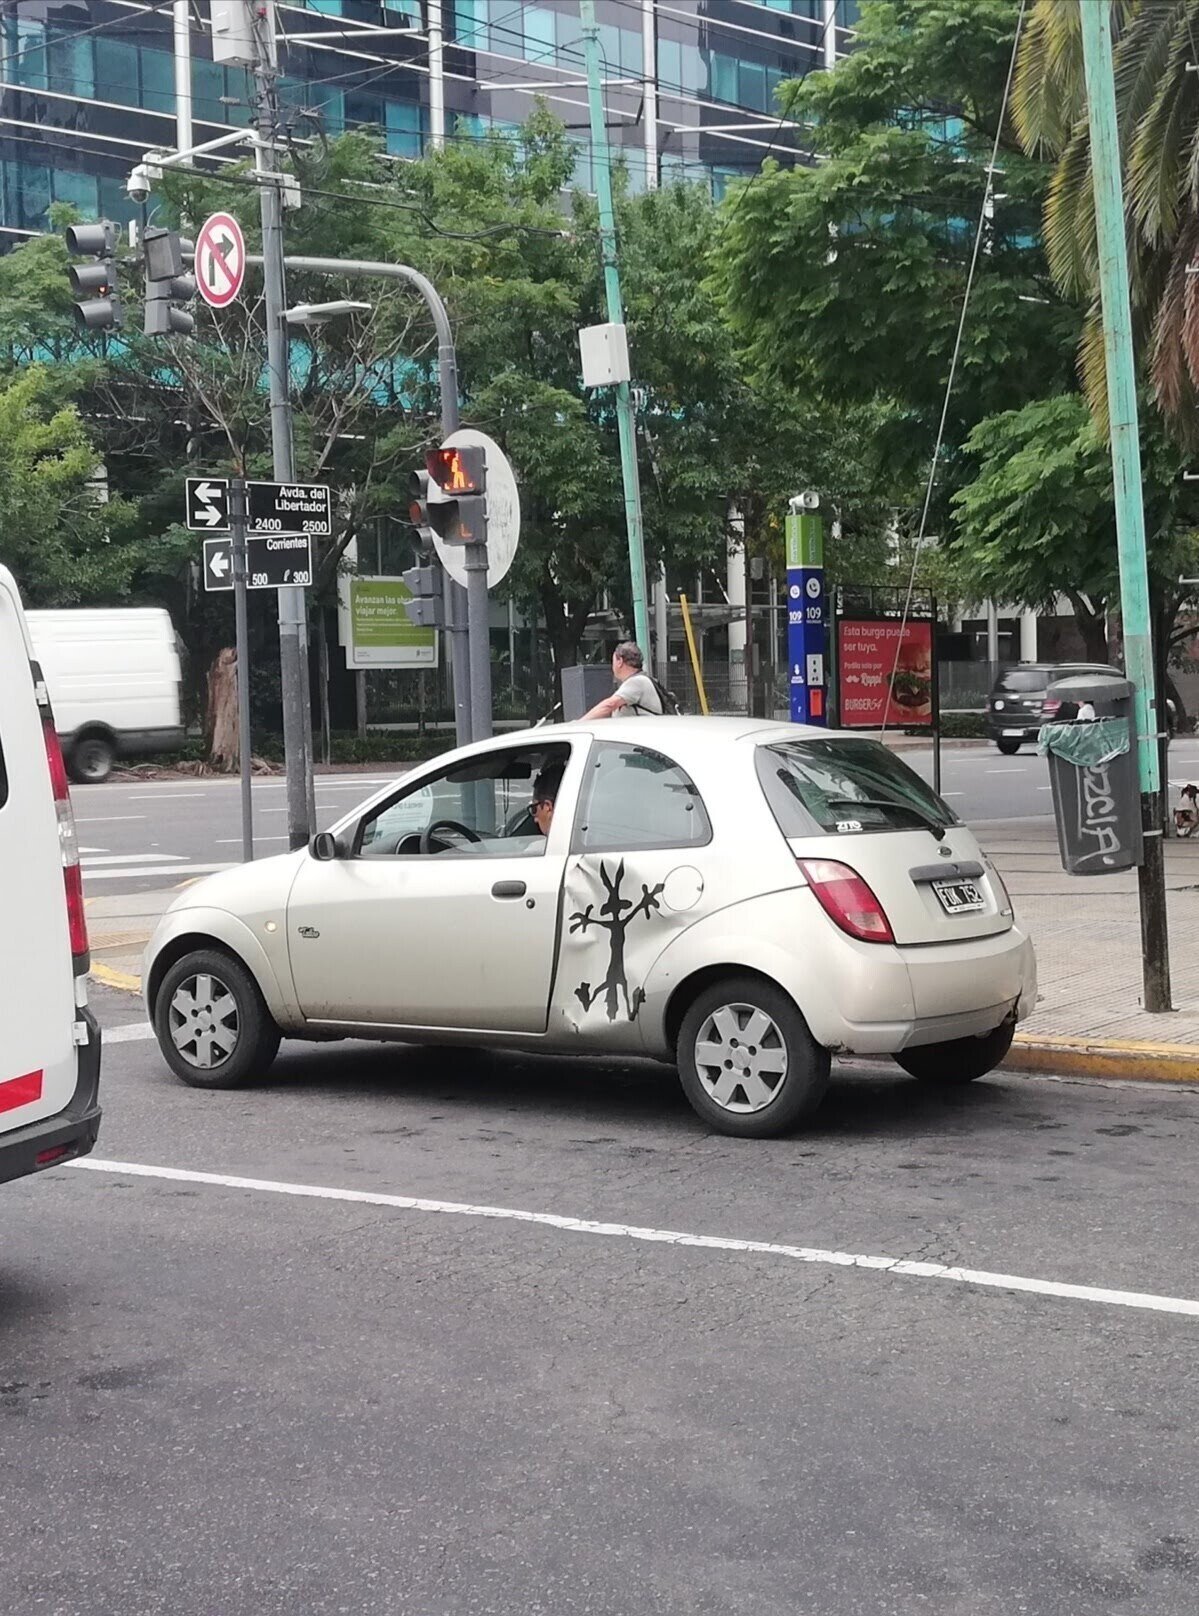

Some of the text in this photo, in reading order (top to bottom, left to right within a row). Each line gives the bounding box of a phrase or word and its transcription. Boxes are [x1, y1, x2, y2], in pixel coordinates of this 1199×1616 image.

[279, 486, 326, 499] Avda. del
[275, 499, 327, 512] Libertador
[255, 518, 328, 532] 2400 2500
[266, 538, 307, 550] Corrientes
[252, 571, 309, 585] 500 300
[789, 611, 803, 621] 109
[806, 607, 822, 619] 109
[844, 626, 860, 636] Esta
[861, 626, 885, 640] burga
[843, 643, 857, 651] ser
[860, 672, 882, 687] Rappi
[959, 885, 983, 903] 752
